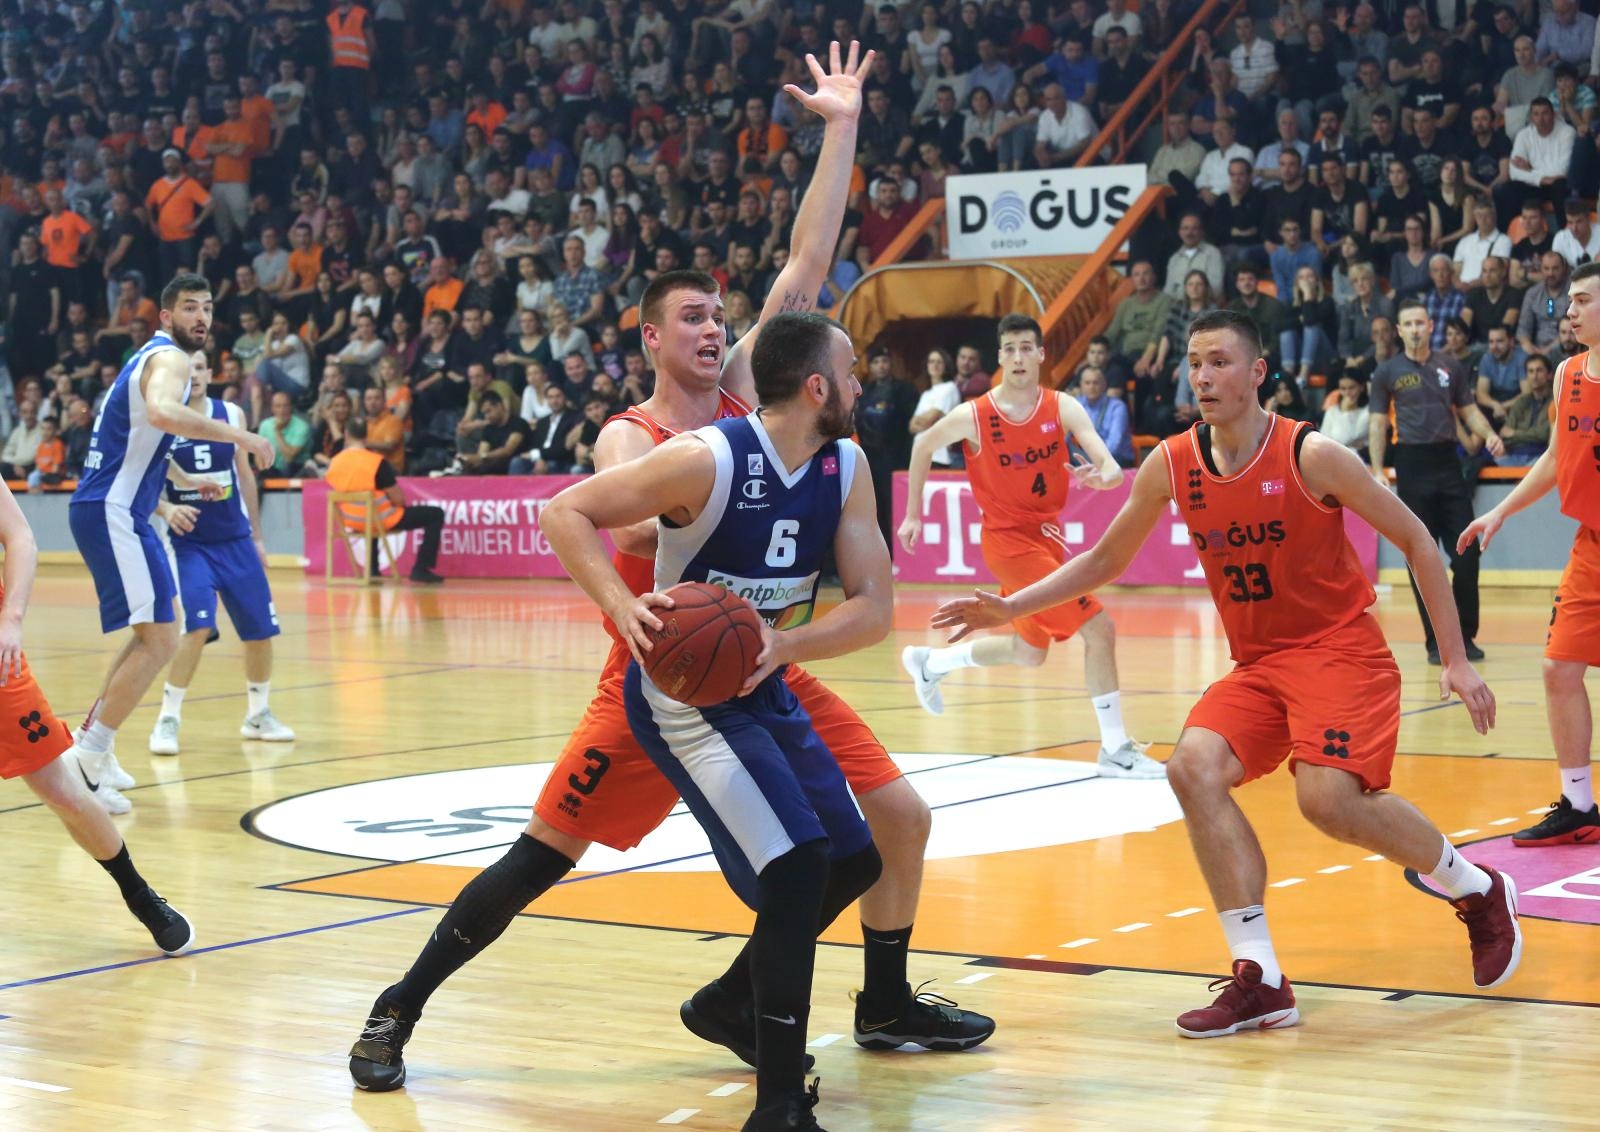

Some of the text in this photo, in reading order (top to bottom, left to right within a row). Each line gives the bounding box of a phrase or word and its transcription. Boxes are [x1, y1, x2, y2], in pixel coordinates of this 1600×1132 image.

[193, 445, 212, 471] 5
[1031, 472, 1047, 497] 4
[737, 501, 771, 511] Champion
[764, 519, 800, 568] 6
[1223, 563, 1274, 603] 33
[567, 747, 611, 796] 3
